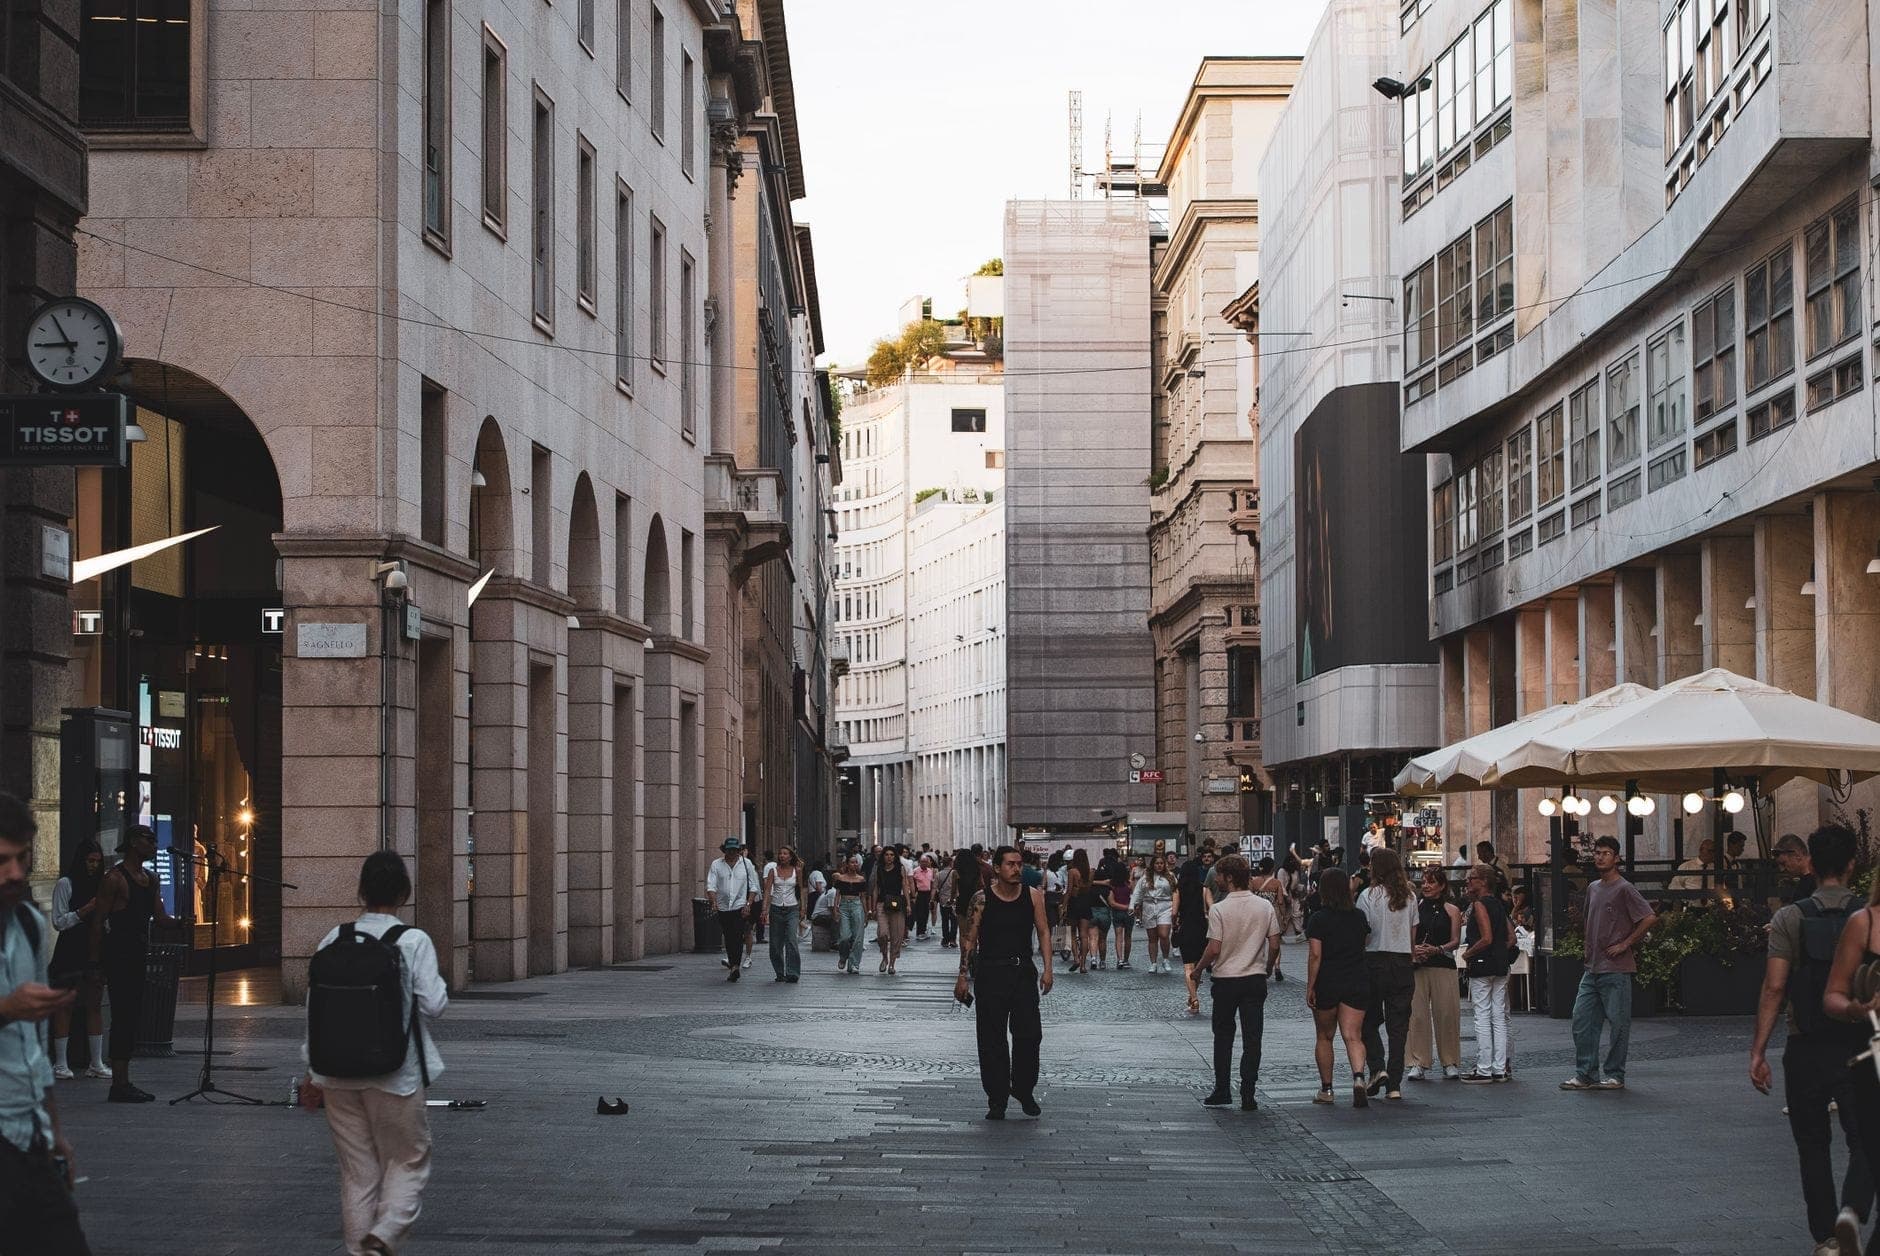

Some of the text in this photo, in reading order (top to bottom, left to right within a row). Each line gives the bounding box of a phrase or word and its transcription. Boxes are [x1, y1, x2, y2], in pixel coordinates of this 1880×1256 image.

[50, 411, 61, 422] T
[20, 427, 108, 442] TISSOT
[265, 612, 284, 630] T
[153, 728, 181, 749] TISSOT
[1420, 809, 1437, 818] ICE
